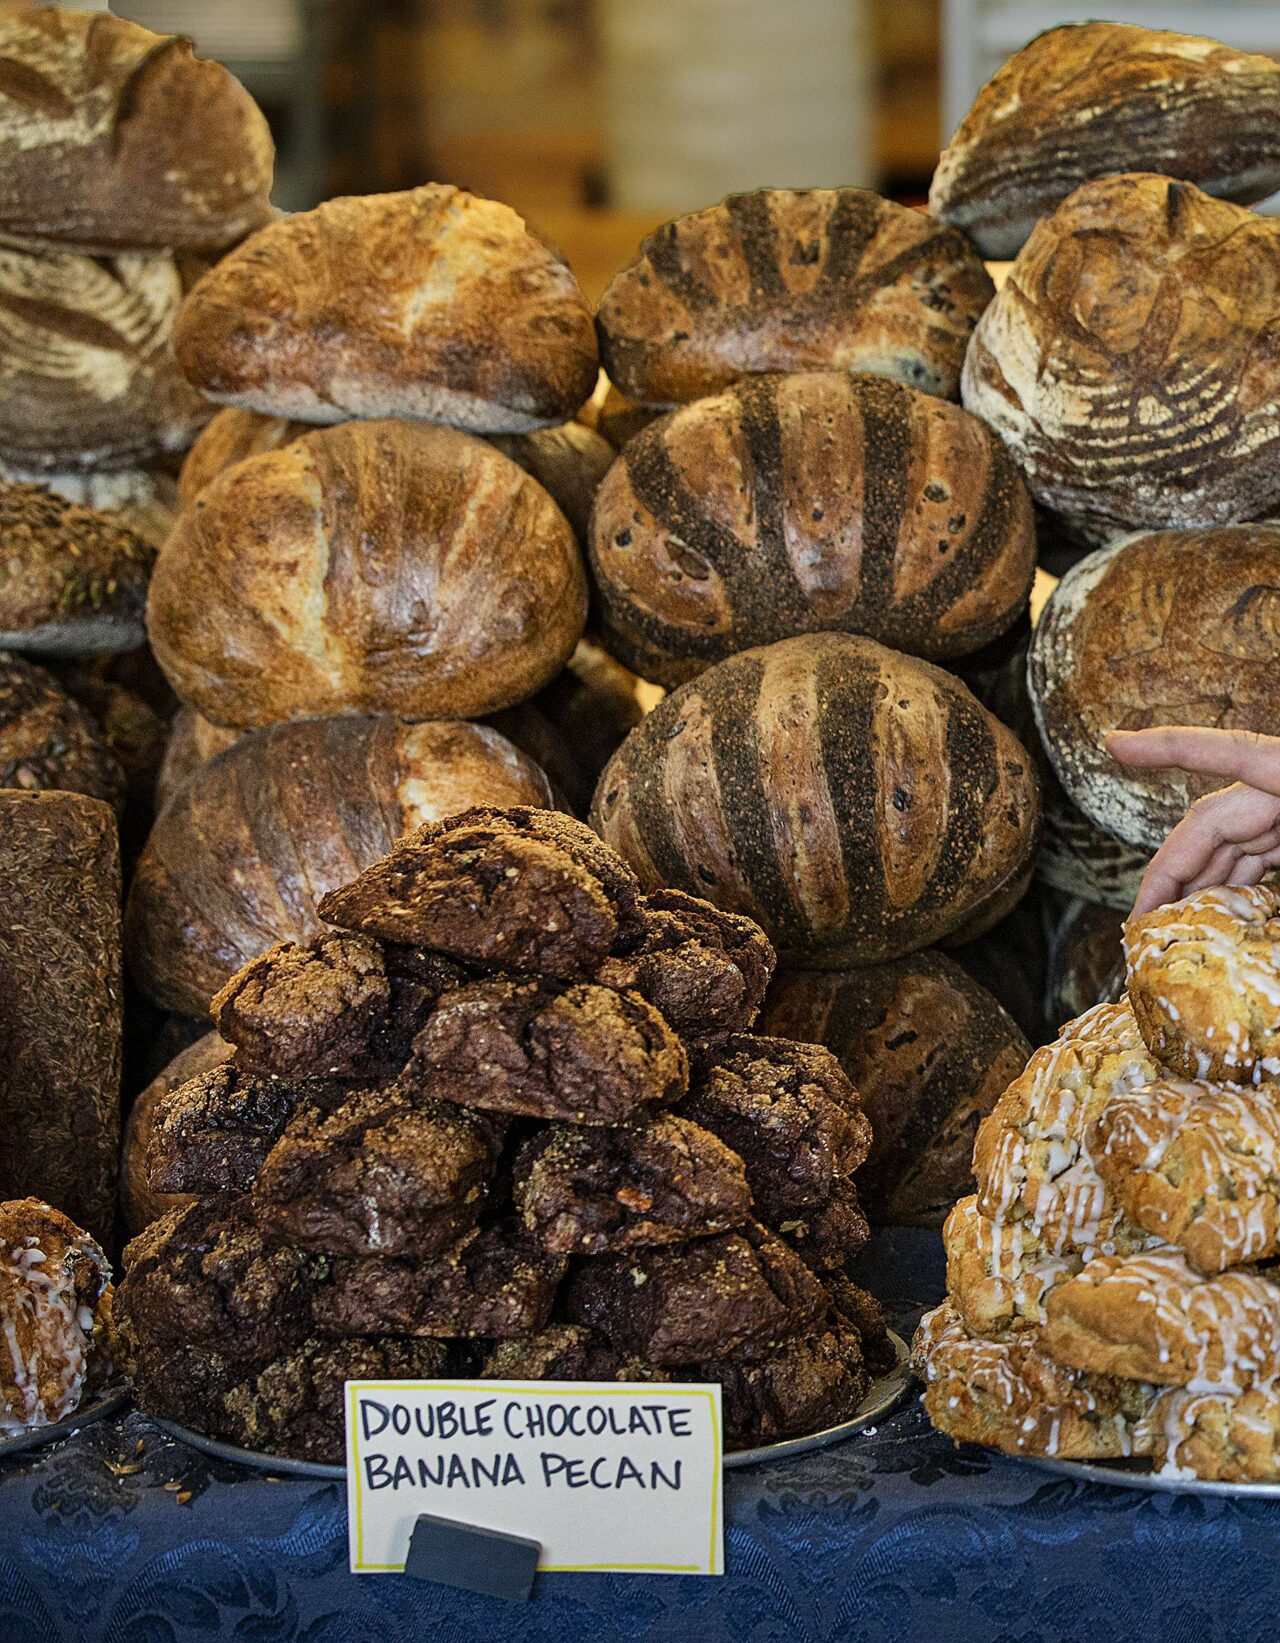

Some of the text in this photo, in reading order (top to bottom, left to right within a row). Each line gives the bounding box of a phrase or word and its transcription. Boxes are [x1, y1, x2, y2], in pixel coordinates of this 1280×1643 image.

[359, 1399, 693, 1440] DOUBLE CHOCOLATE
[364, 1452, 682, 1490] BANANA PECAN
